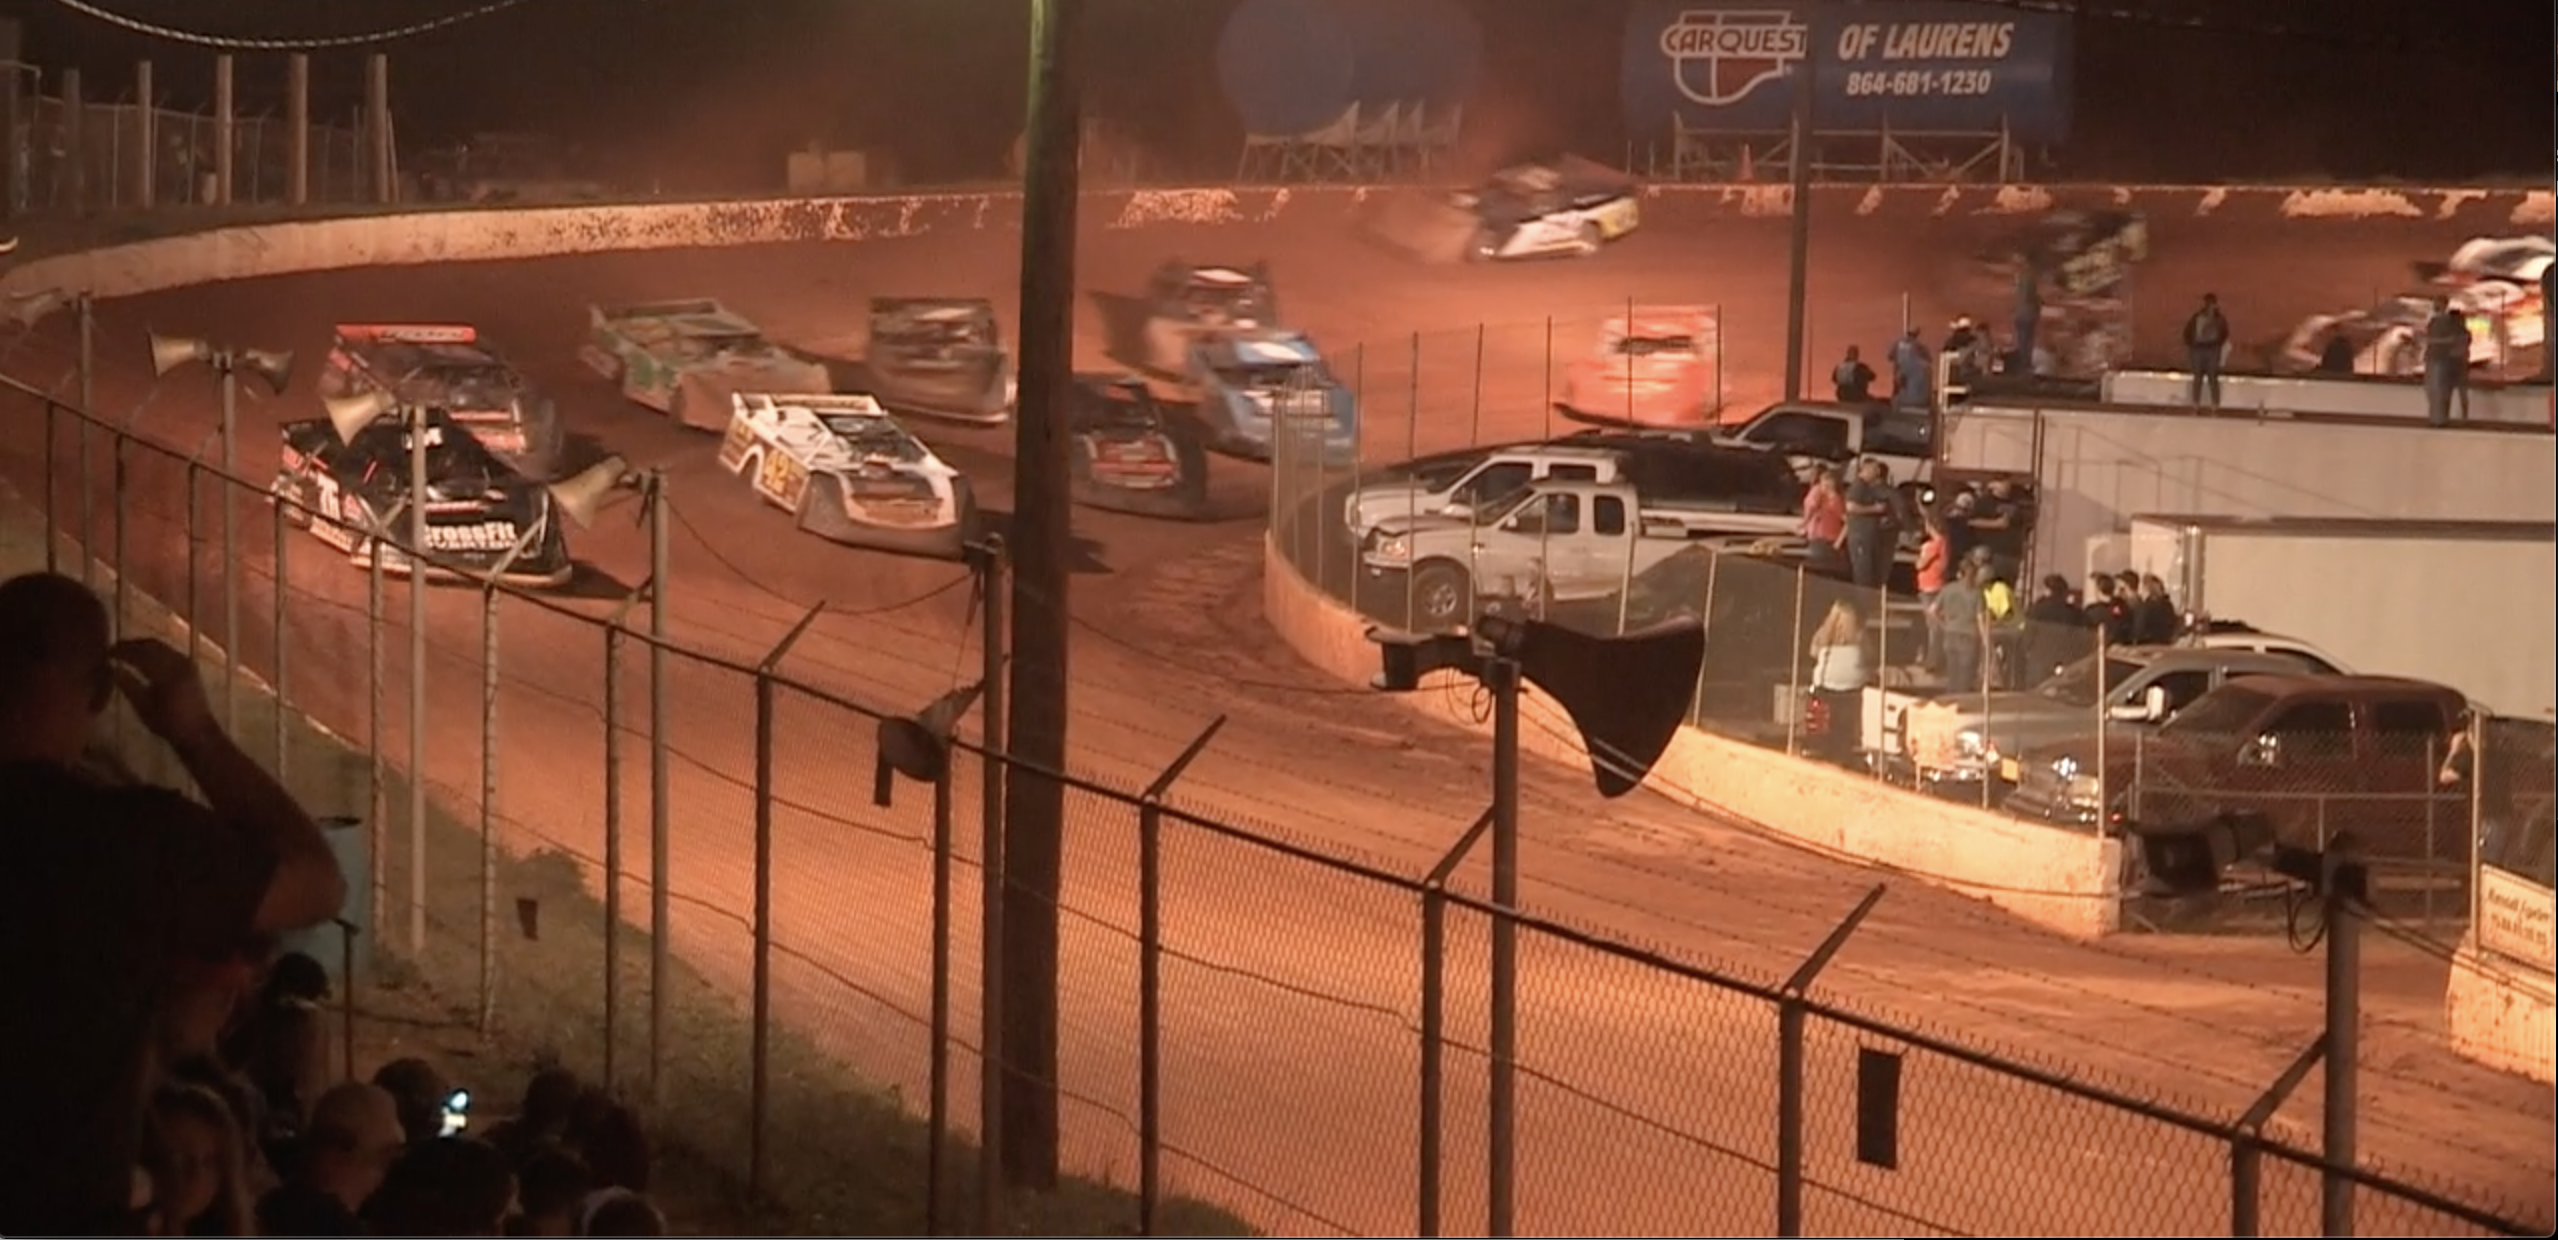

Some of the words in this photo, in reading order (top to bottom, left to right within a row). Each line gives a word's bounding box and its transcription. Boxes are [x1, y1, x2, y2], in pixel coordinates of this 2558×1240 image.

[1665, 28, 1806, 53] CARQUEST
[1838, 24, 1880, 60] OF
[1882, 22, 2014, 59] LAURENS
[1846, 69, 1991, 95] 864-681-1230
